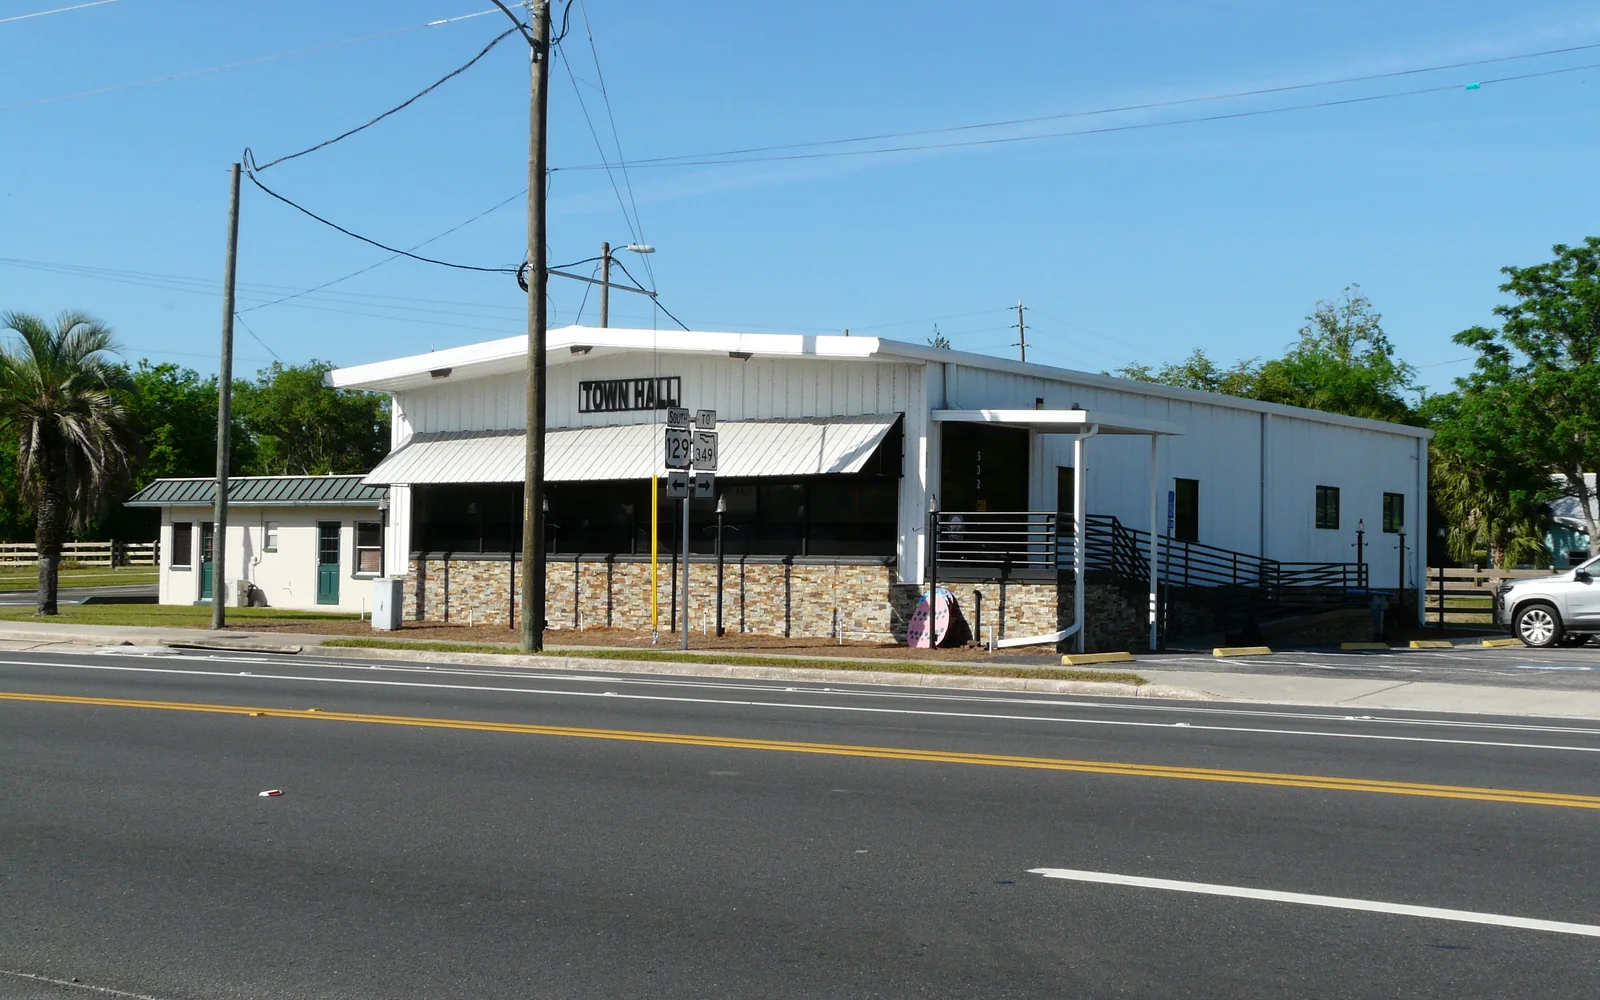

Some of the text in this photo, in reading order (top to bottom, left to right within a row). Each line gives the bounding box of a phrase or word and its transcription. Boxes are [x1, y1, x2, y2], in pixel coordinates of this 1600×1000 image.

[583, 378, 677, 411] TOWN HALL
[668, 411, 688, 424] SOUTH
[701, 414, 711, 425] TO
[667, 437, 689, 459] 129
[695, 447, 713, 462] 349
